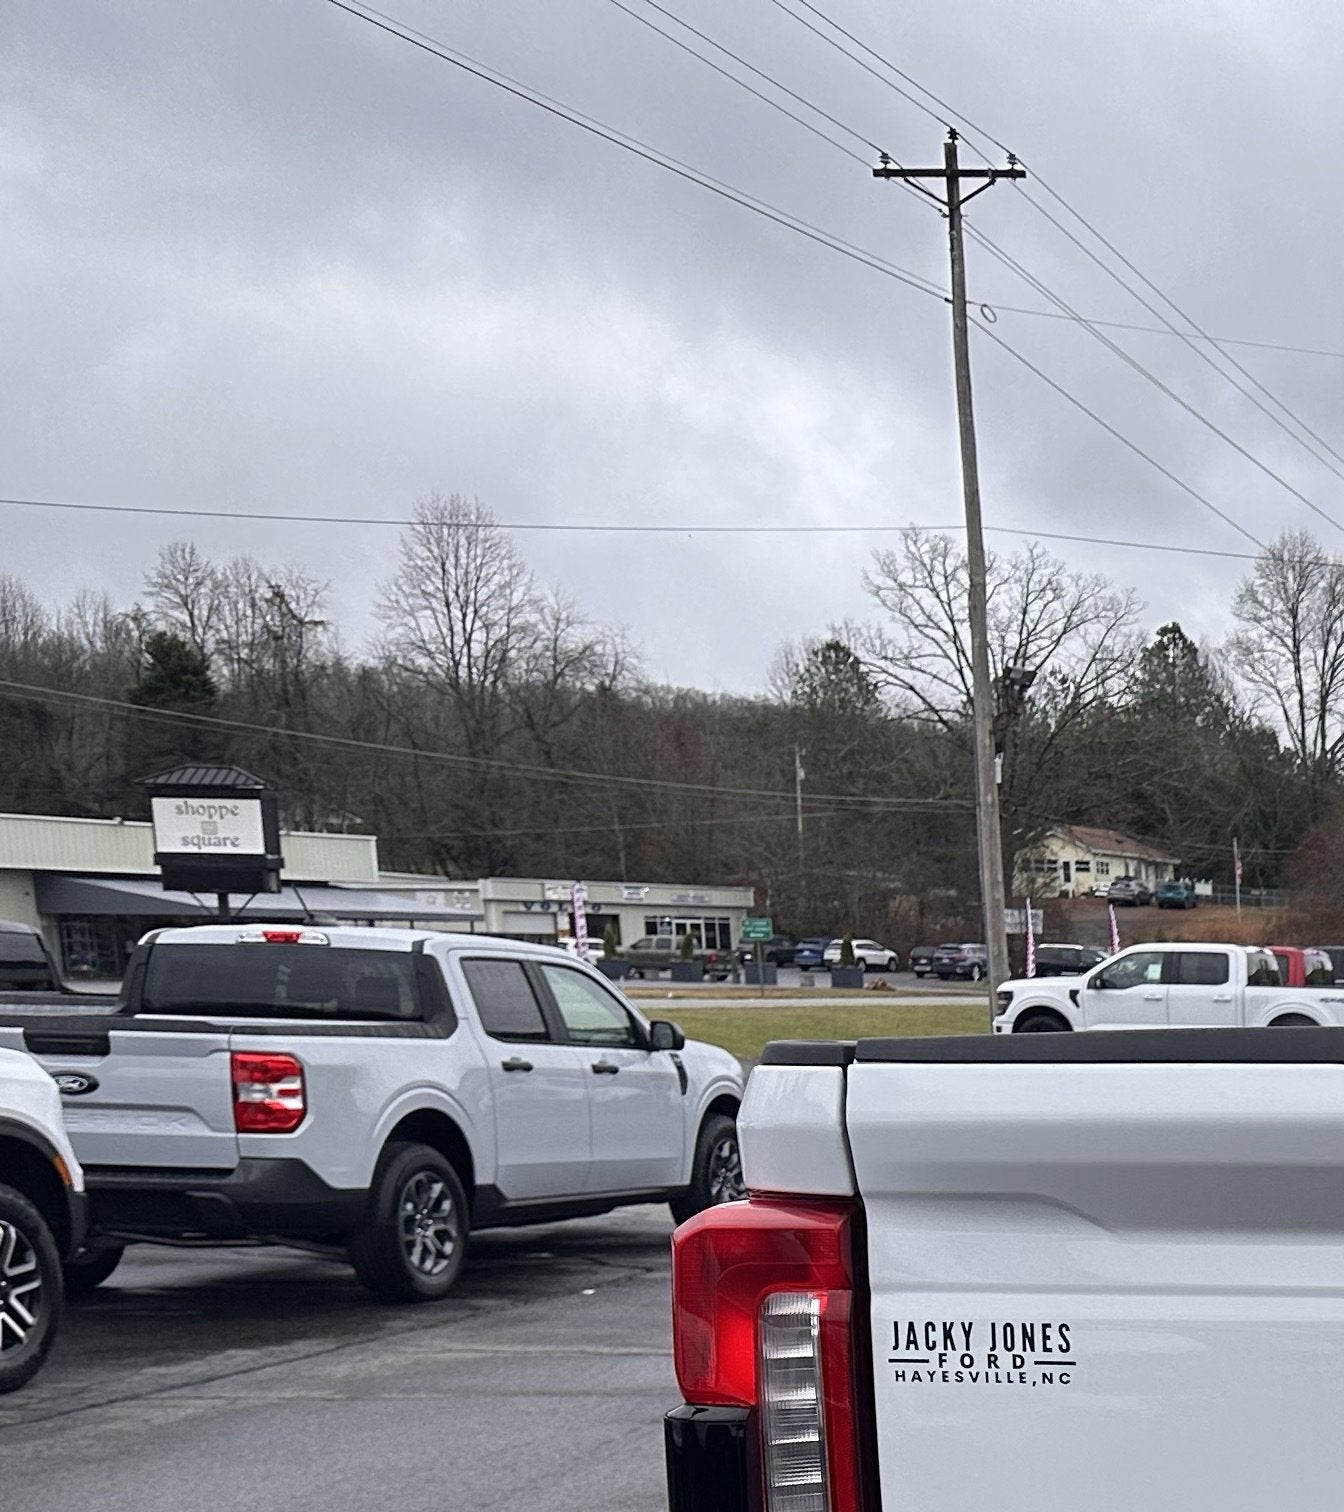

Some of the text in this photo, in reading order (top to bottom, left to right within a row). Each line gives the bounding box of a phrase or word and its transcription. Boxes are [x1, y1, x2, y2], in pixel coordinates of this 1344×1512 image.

[175, 801, 240, 820] shoppe
[181, 835, 240, 850] square
[520, 901, 603, 914] VOLO
[892, 1320, 1071, 1353] JACKY JONES
[937, 1352, 1026, 1370] FORD
